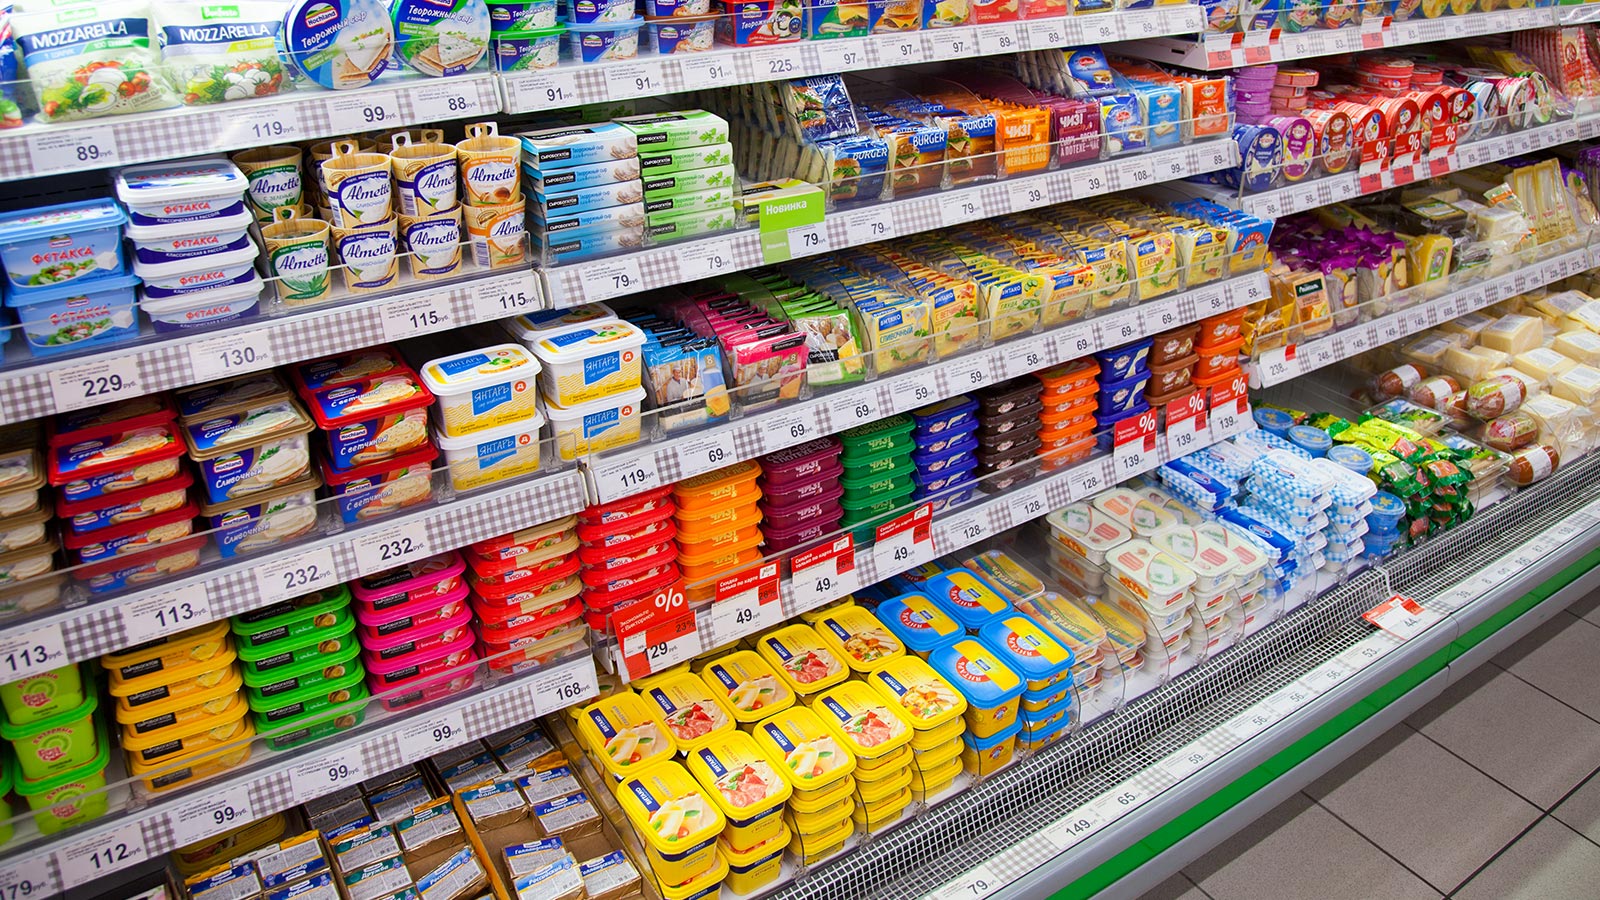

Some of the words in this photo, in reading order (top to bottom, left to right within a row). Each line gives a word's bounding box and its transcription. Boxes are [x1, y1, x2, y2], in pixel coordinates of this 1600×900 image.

[307, 10, 337, 28] Hochland
[408, 5, 456, 20] Творожный
[457, 12, 475, 25] сыр
[300, 22, 349, 49] Творожный
[350, 11, 367, 24] сыр
[1143, 22, 1153, 33] 89
[1186, 18, 1195, 29] 89
[32, 20, 128, 50] MOZZARELLA
[180, 23, 270, 41] MOZZARELLA
[1048, 32, 1060, 42] 89
[1099, 26, 1110, 37] 98
[901, 44, 913, 55] 97
[953, 41, 964, 53] 97
[999, 37, 1011, 48] 89
[1296, 44, 1305, 53] 83
[844, 53, 858, 64] 97
[709, 66, 724, 79] 91
[768, 59, 793, 73] 225
[636, 76, 652, 90] 91
[805, 74, 840, 87] BURGER
[547, 88, 563, 102] 91
[448, 96, 467, 111] 88
[363, 106, 385, 122] 99
[1060, 114, 1083, 128] ЧИЗ!
[252, 120, 283, 138] 119
[962, 117, 994, 131] BURGER
[1006, 124, 1031, 138] ЧИЗ!
[913, 132, 945, 146] BURGER
[76, 146, 100, 160] 89
[853, 148, 887, 160] BURGER
[1214, 154, 1223, 165] 89
[468, 167, 516, 183] Almette
[1133, 170, 1148, 181] 108
[1171, 163, 1181, 174] 99
[253, 176, 301, 194] Almette
[1089, 178, 1100, 190] 39
[343, 184, 391, 203] Almette
[1029, 190, 1041, 202] 39
[163, 201, 211, 214] ФЕТАКСА
[765, 199, 807, 215] Новинка
[962, 202, 974, 215] 79
[1267, 204, 1276, 214] 98
[871, 223, 885, 234] 79
[172, 236, 219, 249] ФЕТАКСА
[410, 230, 459, 248] Almette
[804, 232, 819, 246] 79
[31, 246, 94, 265] ФЕТАКСА
[345, 244, 393, 262] Almette
[276, 253, 327, 271] Almette
[707, 255, 722, 269] 79
[179, 271, 225, 285] ФЕТАКСА
[612, 275, 630, 289] 79
[1248, 288, 1258, 297] 58
[500, 292, 526, 309] 115
[1211, 298, 1221, 308] 58
[410, 310, 439, 328] 115
[1162, 313, 1172, 324] 69
[1122, 326, 1132, 336] 69
[1077, 339, 1087, 350] 69
[219, 346, 256, 368] 130
[586, 354, 619, 370] ЯНТАРЬ
[1027, 354, 1038, 366] 58
[970, 371, 982, 383] 59
[83, 374, 123, 397] 229
[1232, 379, 1247, 398] %
[474, 385, 509, 401] ЯНТАРЬ
[915, 387, 928, 400] 59
[1189, 393, 1204, 414] %
[584, 409, 617, 425] ЯНТАРЬ
[855, 404, 869, 418] 69
[1140, 413, 1156, 434] %
[1219, 415, 1235, 430] 139
[341, 430, 366, 441] Hochland
[790, 423, 805, 437] 69
[340, 447, 346, 455] С
[348, 435, 388, 452] ветчиной
[479, 440, 514, 454] ЯНТАРЬ
[1176, 433, 1192, 448] 139
[709, 448, 724, 462] 69
[1124, 454, 1140, 469] 139
[214, 459, 242, 472] Hochland
[216, 466, 263, 489] Сливочный
[621, 469, 645, 487] 119
[1082, 478, 1097, 490] 128
[1025, 501, 1041, 514] 128
[605, 514, 625, 523] VIOLA
[963, 525, 980, 538] 128
[380, 537, 413, 560] 232
[504, 548, 524, 557] VIOLA
[894, 547, 908, 561] 49
[610, 559, 630, 568] VIOLA
[795, 553, 812, 563] Скидка
[795, 559, 812, 569] только
[818, 549, 832, 558] карте
[284, 565, 319, 588] 232
[508, 571, 528, 580] VIOLA
[719, 582, 737, 593] только
[745, 575, 759, 584] карте
[720, 579, 738, 587] Скидка
[815, 577, 830, 593] 49
[511, 593, 531, 602] VIOLA
[655, 589, 683, 612] %
[155, 603, 194, 626] 113
[620, 609, 650, 627] Экономьте
[625, 612, 655, 631] Викторией
[736, 608, 753, 624] 49
[676, 619, 695, 633] 23%
[5, 646, 48, 671] 113
[1326, 669, 1340, 680] 56
[556, 682, 581, 701] 168
[1290, 692, 1305, 703] 56
[1253, 714, 1268, 725] 56
[433, 725, 452, 742] 99
[1189, 753, 1204, 765] 59
[328, 765, 348, 781] 99
[1117, 792, 1136, 806] 65
[214, 807, 235, 823] 99
[412, 810, 439, 825] Дружба
[1066, 819, 1091, 838] 149
[351, 834, 378, 848] Дружба
[90, 844, 129, 869] 112
[362, 864, 389, 880] Дружба
[967, 879, 988, 895] 79
